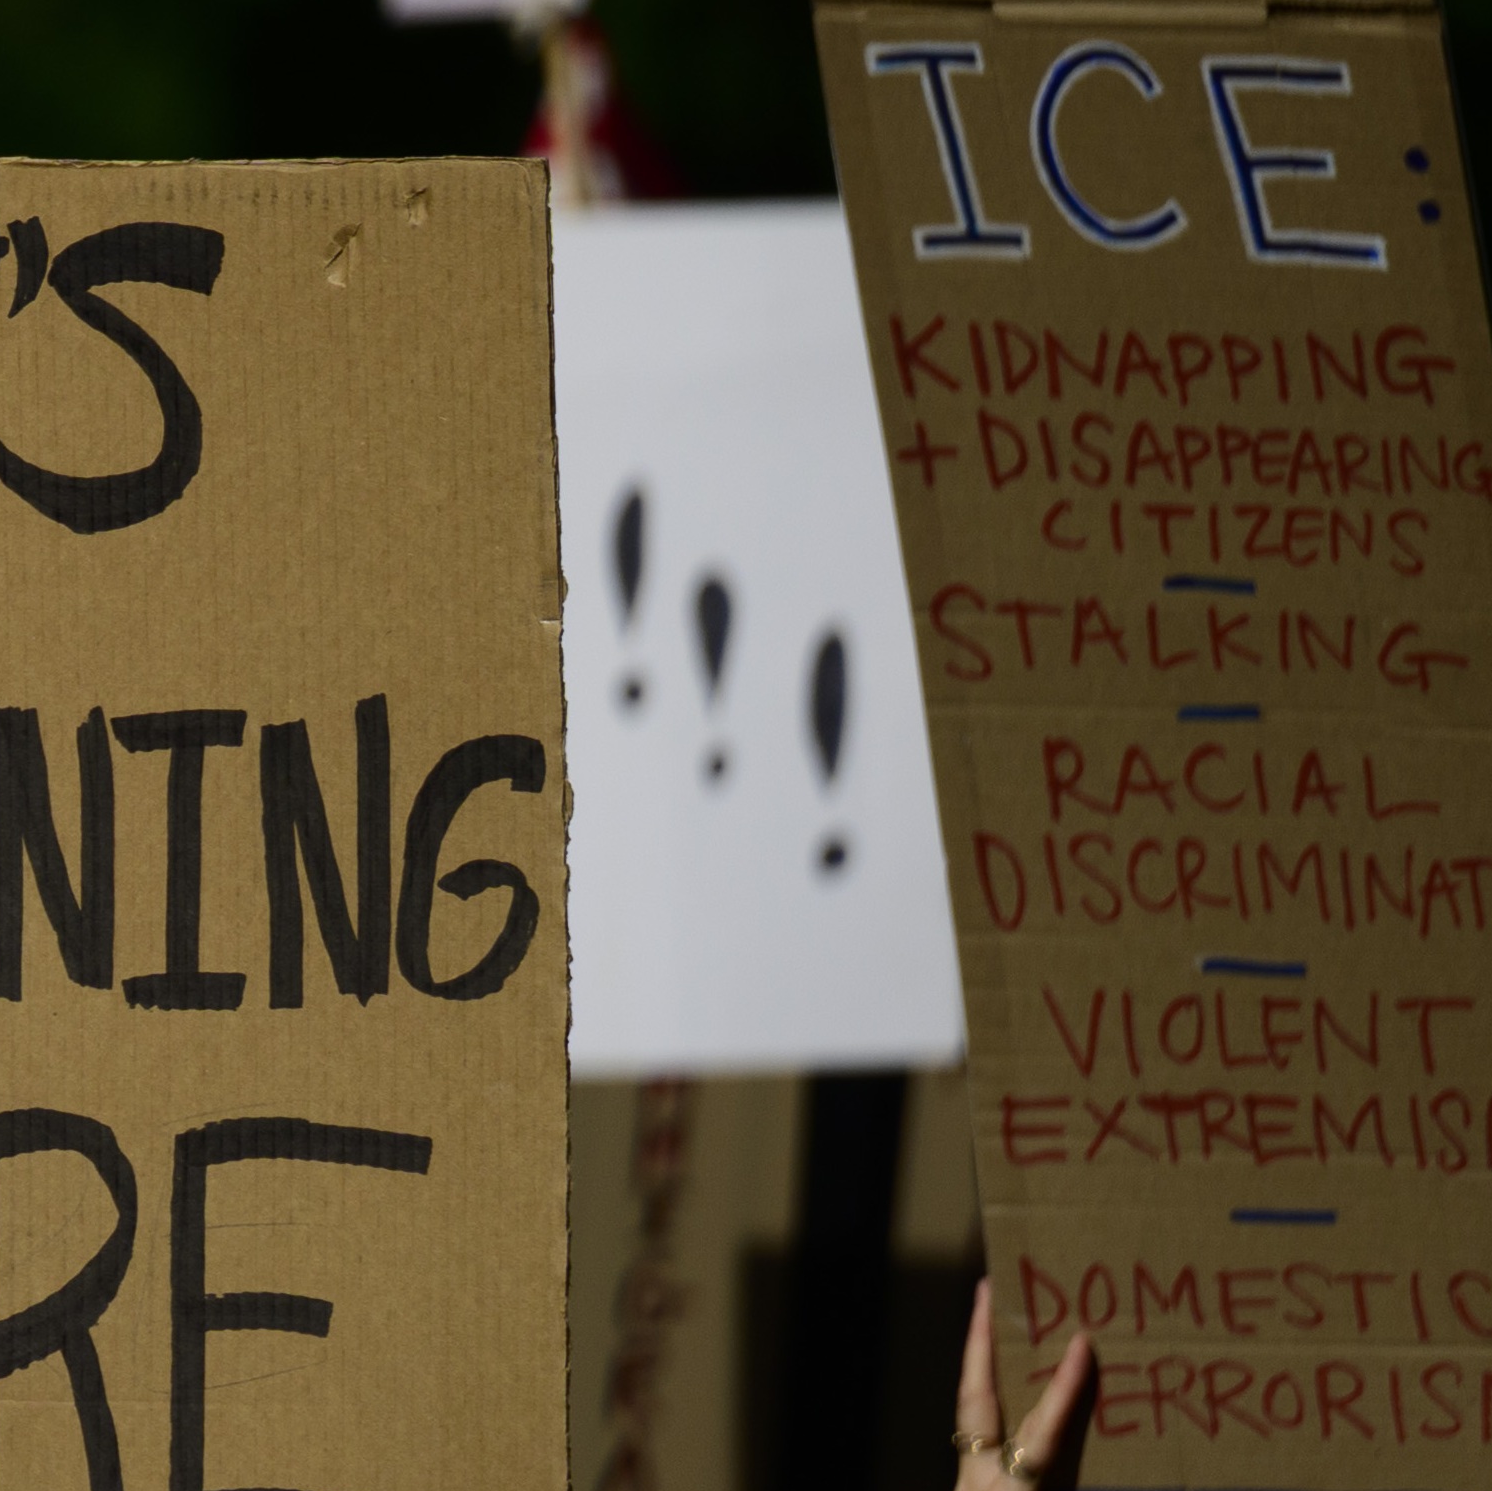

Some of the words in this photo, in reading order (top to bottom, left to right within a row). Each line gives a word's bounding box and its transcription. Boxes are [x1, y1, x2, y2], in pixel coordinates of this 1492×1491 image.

[865, 38, 1441, 272] ICE:
[890, 315, 1455, 406] KIDNAPPING
[978, 408, 1492, 503] DISAPPEARING
[1040, 498, 1429, 575] CITIZENS
[930, 584, 1469, 691] STALKING
[1043, 737, 1441, 823] RACIAL
[1043, 987, 1474, 1078] VIOLENT
[1002, 1088, 1492, 1174] EXTREMIS
[1020, 1256, 1492, 1344] DOMESTIC
